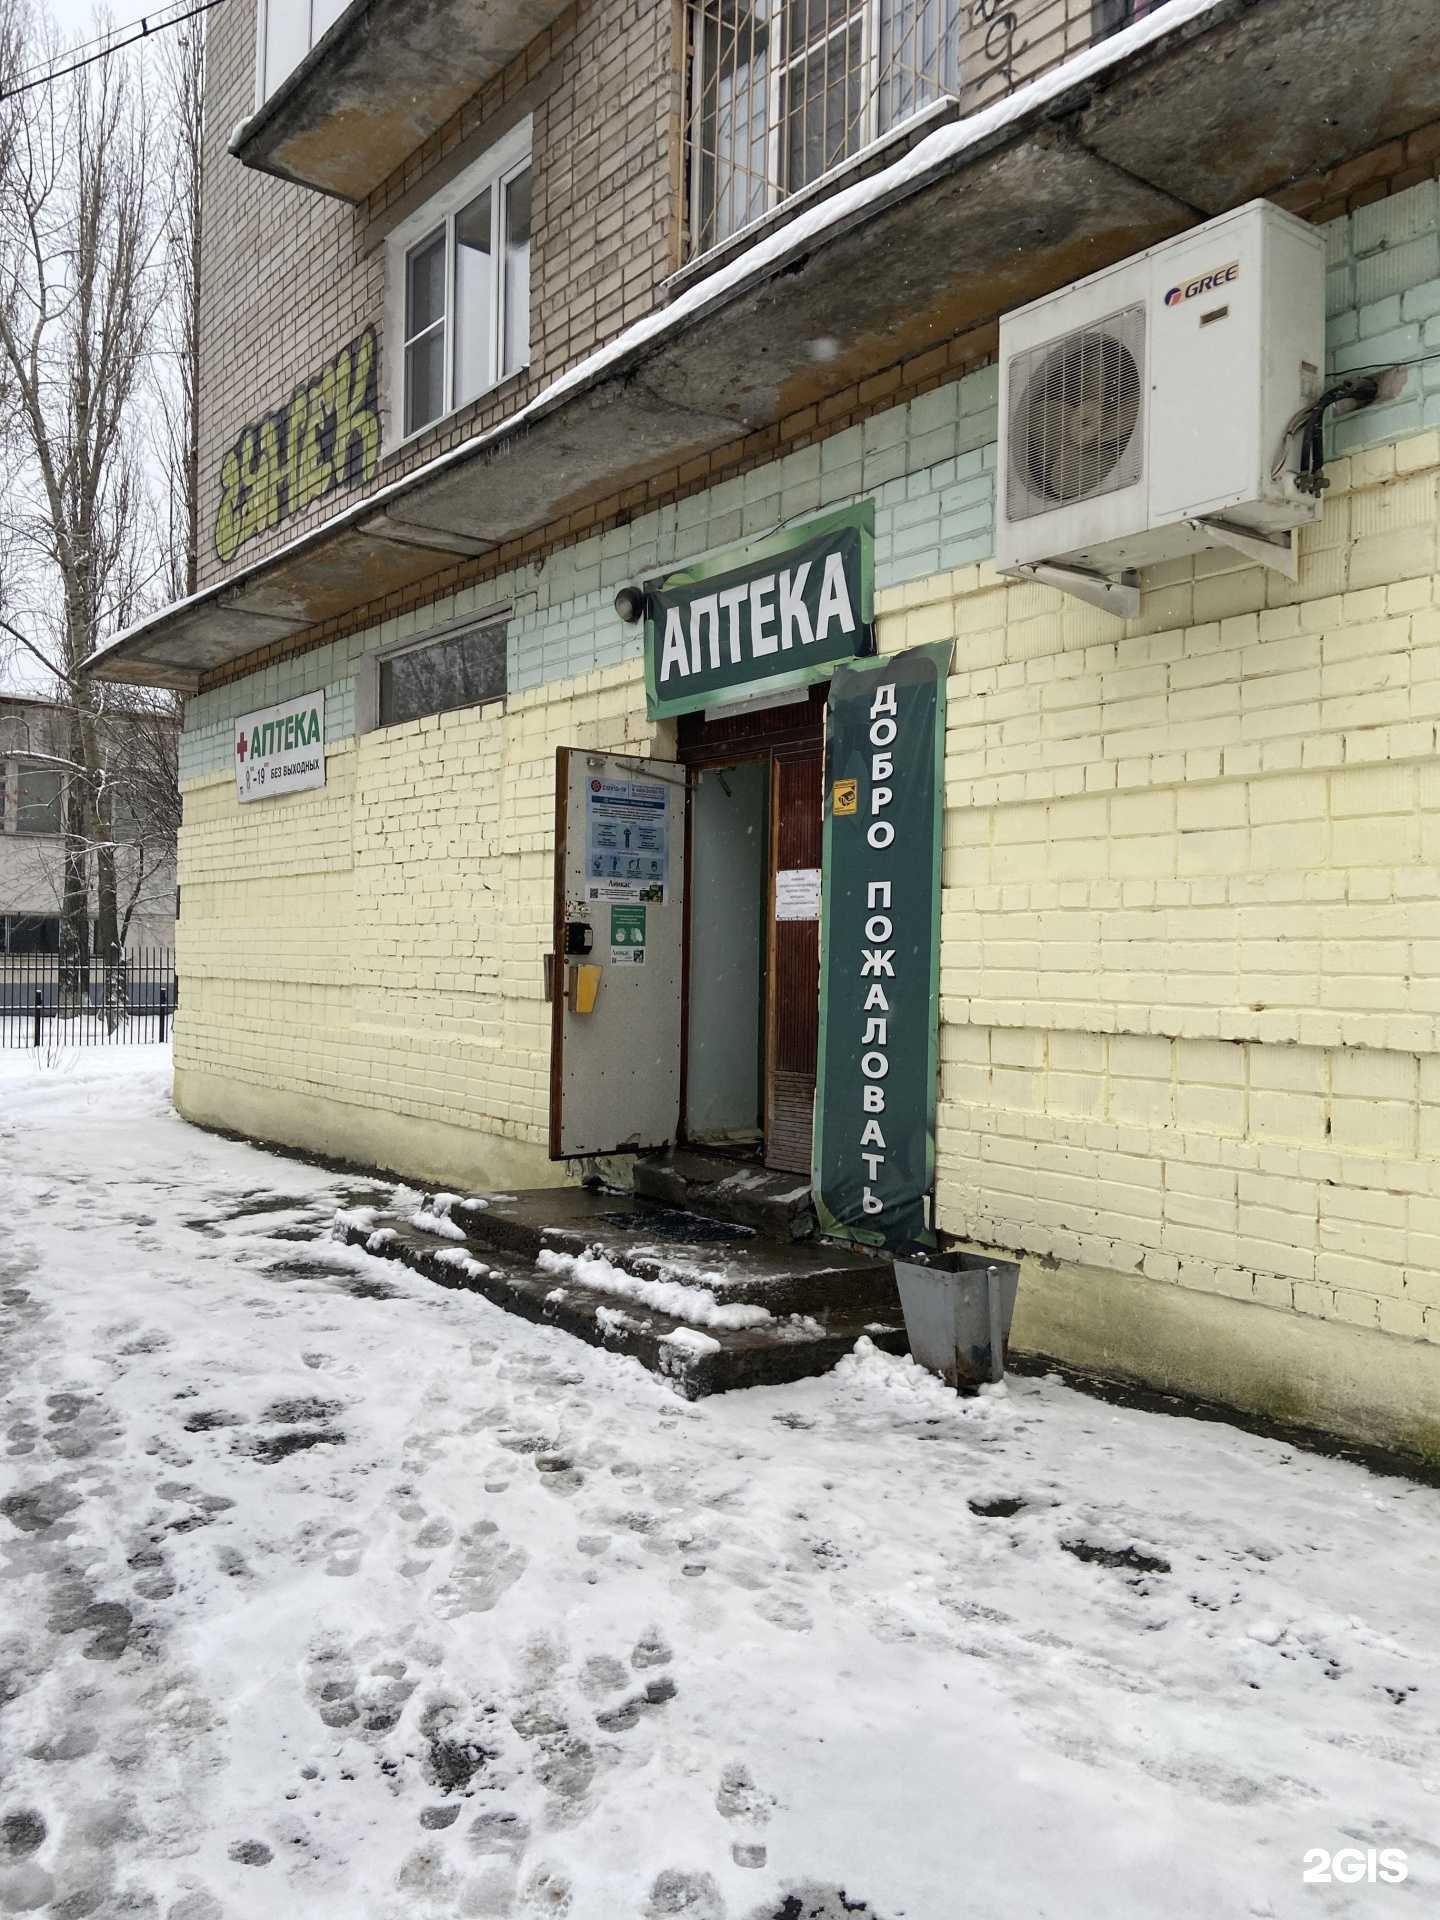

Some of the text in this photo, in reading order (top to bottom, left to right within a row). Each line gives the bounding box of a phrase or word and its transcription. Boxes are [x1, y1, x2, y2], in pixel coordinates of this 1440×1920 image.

[1184, 264, 1239, 298] GREE
[660, 551, 856, 682] АПТЕКА
[250, 708, 320, 760] АПТЕКА
[270, 767, 282, 779] БЕЗ
[283, 759, 320, 776] ВЫХОДНЫХ
[860, 683, 898, 1215] ДОБРО ПОЖАЛОВАТЬ
